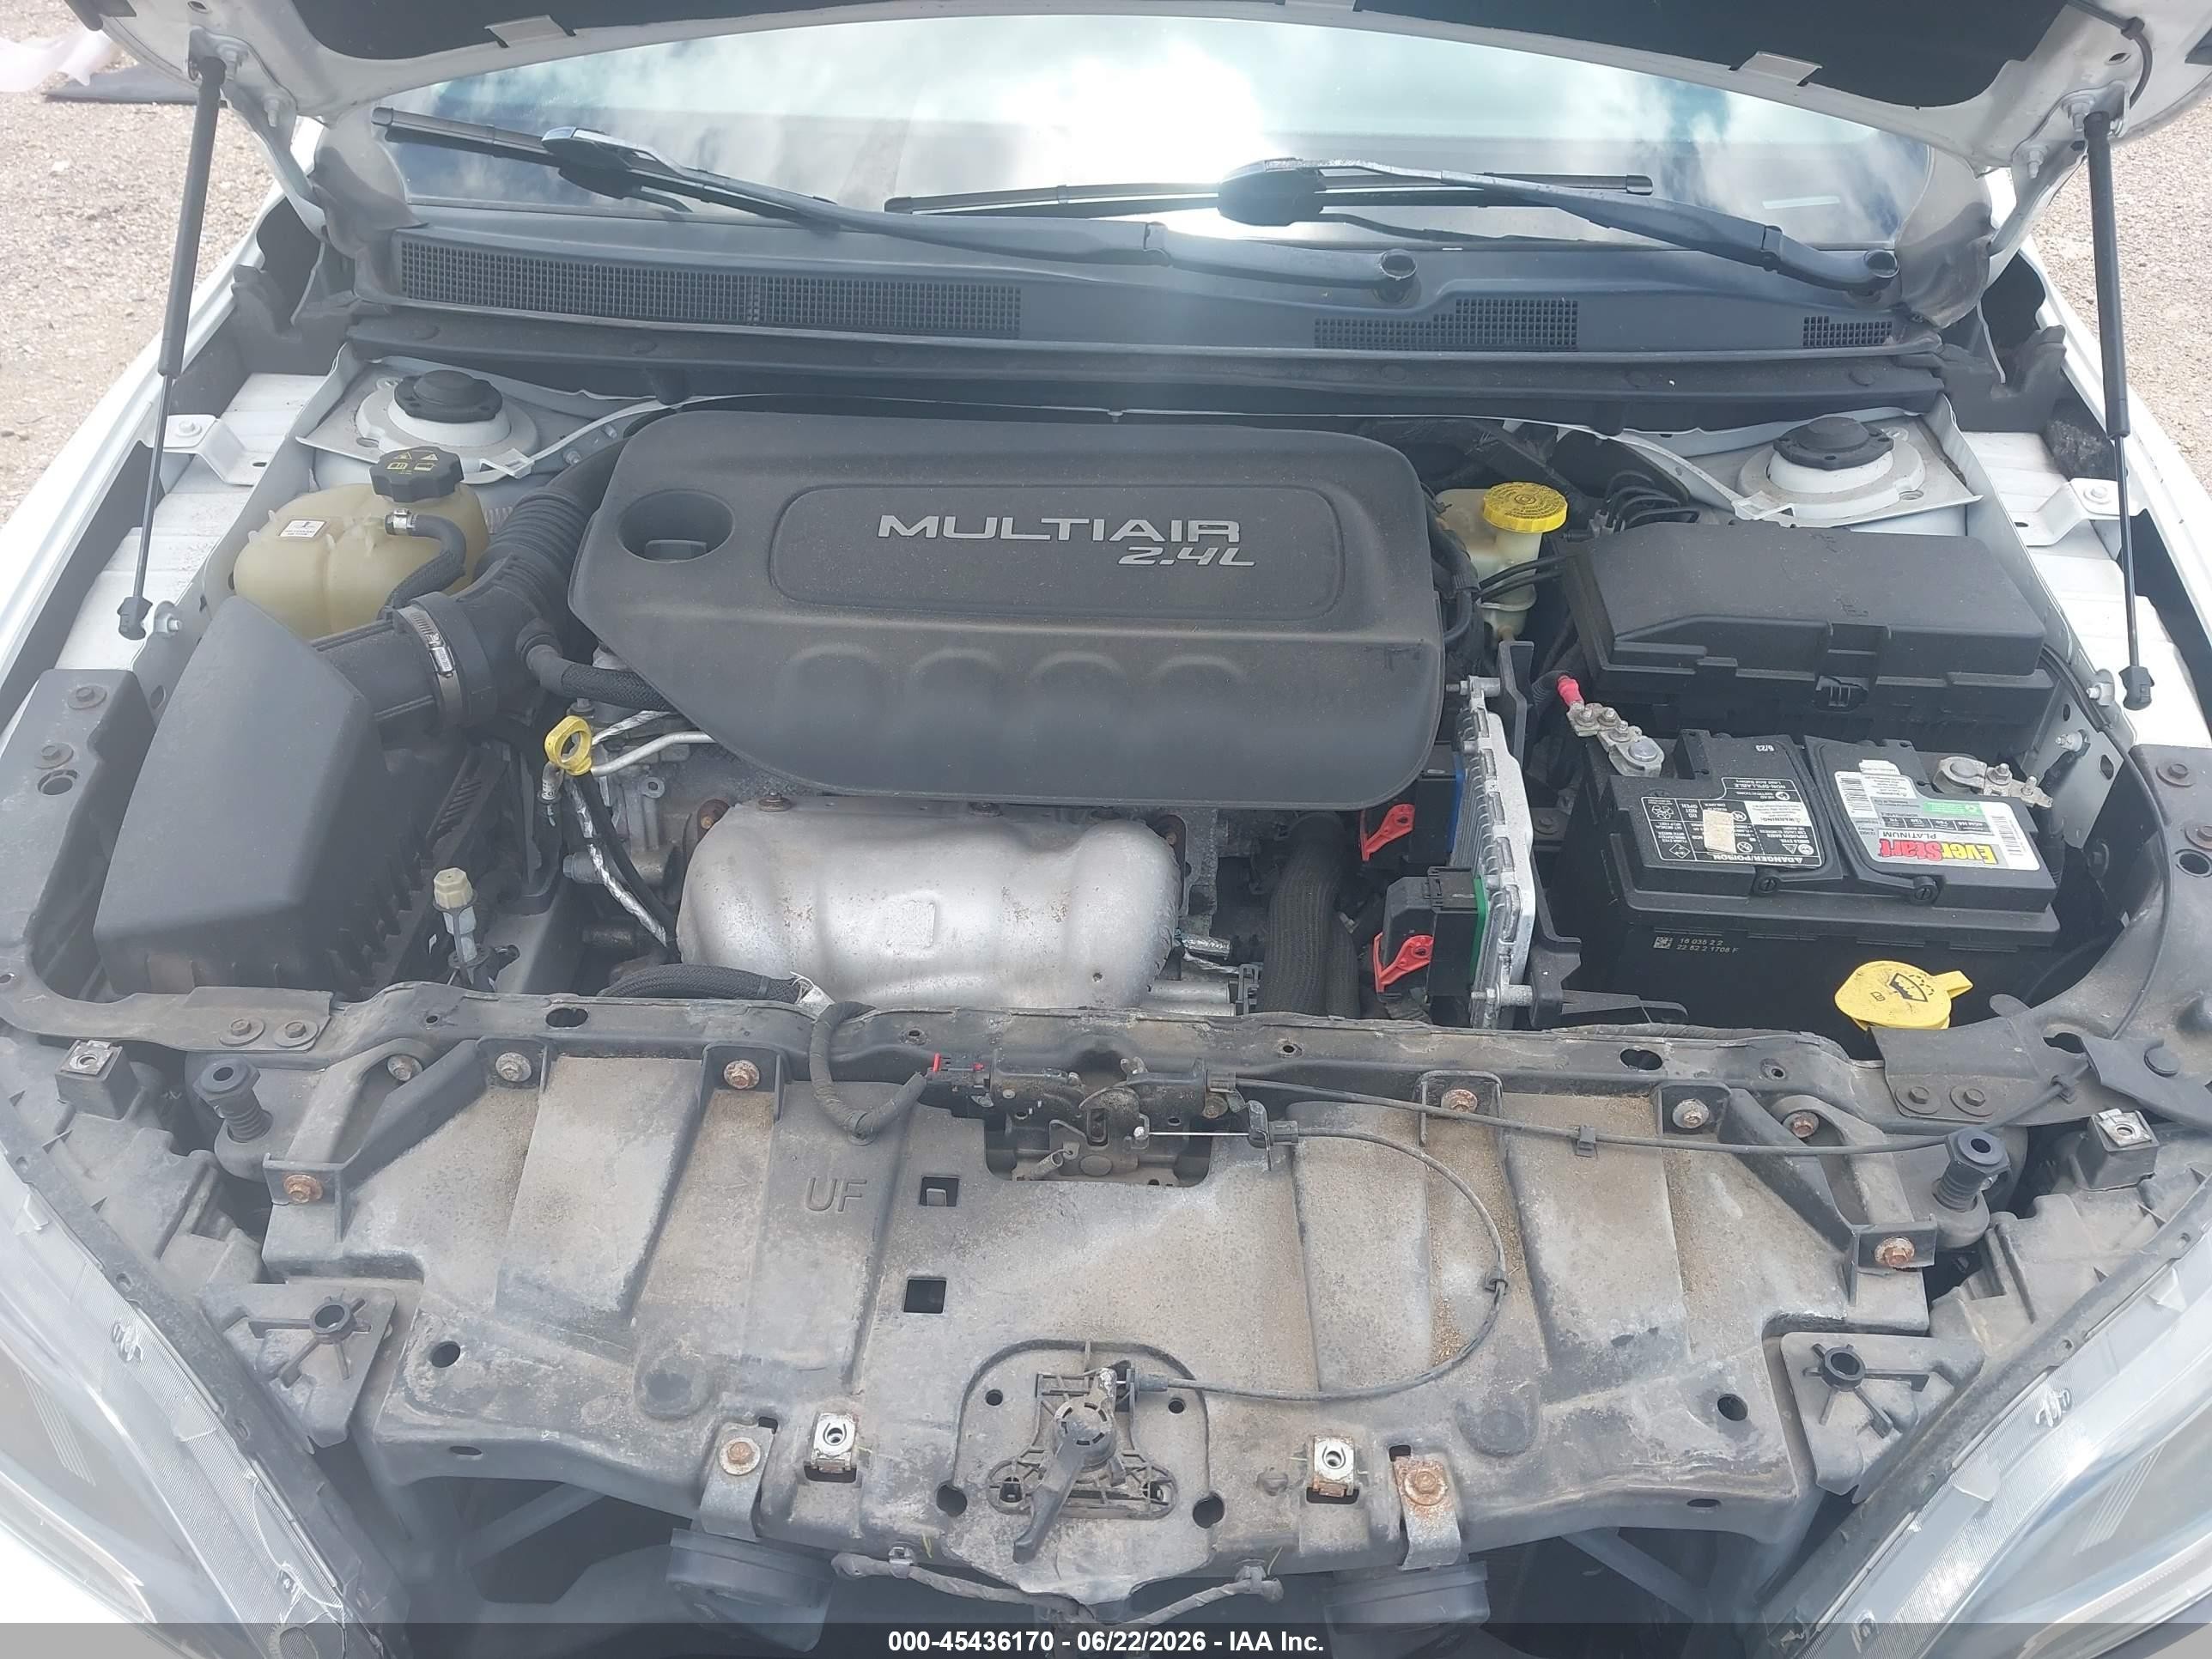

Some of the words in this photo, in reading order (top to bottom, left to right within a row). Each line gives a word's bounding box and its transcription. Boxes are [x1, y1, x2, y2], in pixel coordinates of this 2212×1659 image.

[877, 514, 1241, 543] MULTIAIR
[1117, 546, 1256, 567] 2.4L
[1882, 831, 1937, 840] PLATINUM
[1878, 838, 1998, 865] EverStart
[805, 1176, 868, 1212] UF
